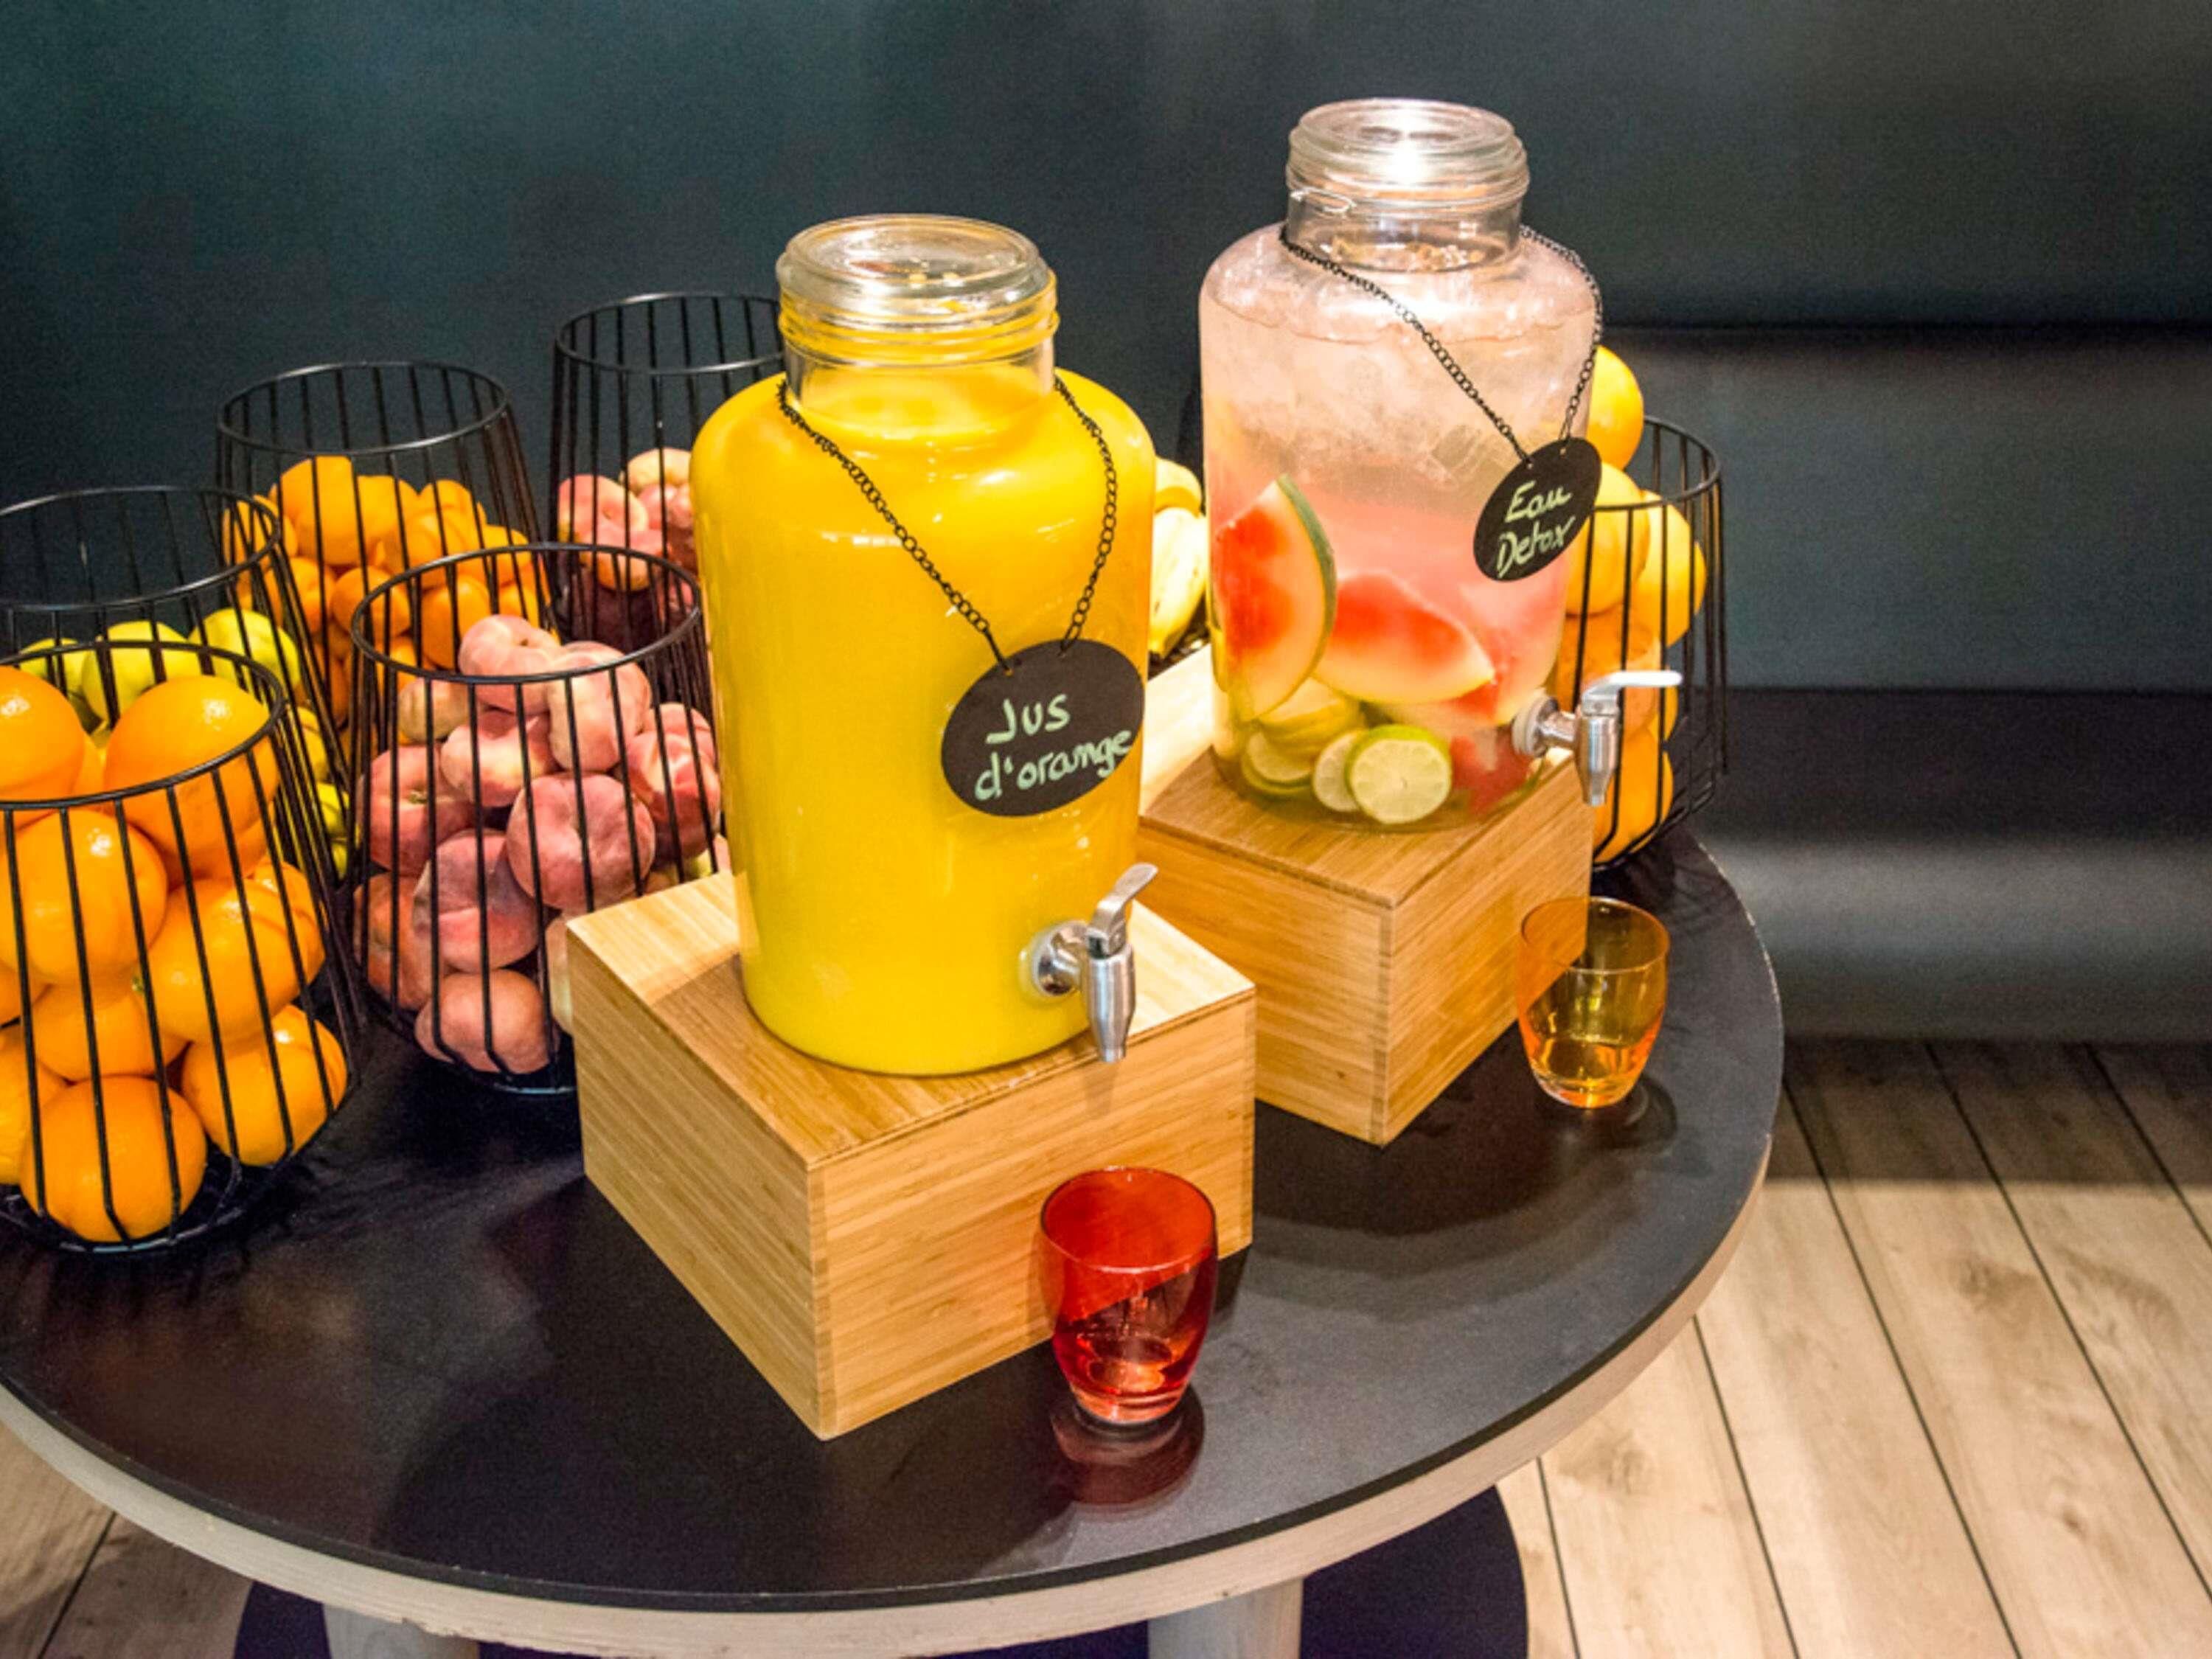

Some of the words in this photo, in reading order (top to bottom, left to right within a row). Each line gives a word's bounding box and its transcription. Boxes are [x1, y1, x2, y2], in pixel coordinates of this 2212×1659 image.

[1504, 480, 1573, 523] Eau
[1496, 515, 1576, 579] Detox
[985, 693, 1071, 744] Jus
[973, 729, 1132, 801] d'orange
